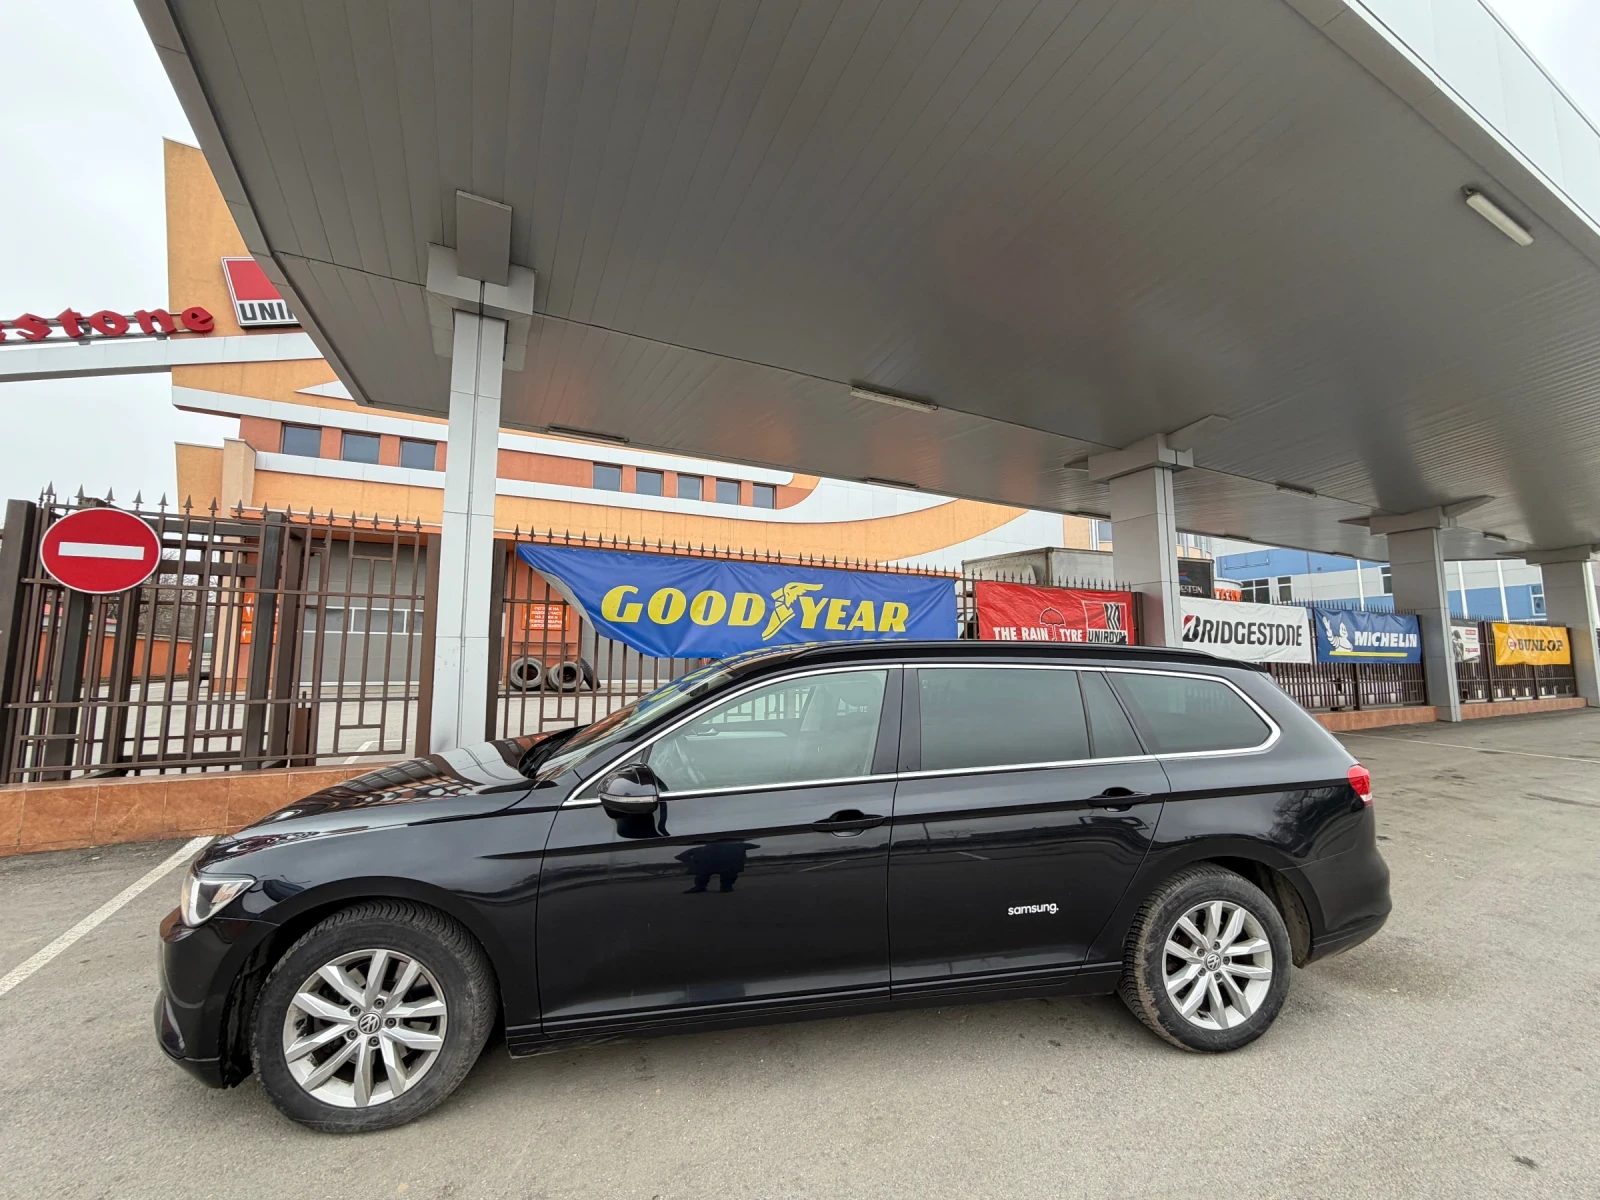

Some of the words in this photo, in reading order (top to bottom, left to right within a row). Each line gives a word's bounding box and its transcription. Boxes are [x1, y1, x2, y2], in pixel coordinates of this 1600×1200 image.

[0, 307, 215, 342] stone
[601, 585, 766, 626] GOOD
[799, 596, 909, 632] YEAR
[993, 627, 1017, 640] THE
[1021, 627, 1048, 641] RAIN
[1059, 628, 1082, 642] TYRE
[1182, 615, 1302, 646] BRIDGESTONE
[1354, 631, 1417, 648] MICHELIN
[1517, 639, 1563, 651] DUNLOP
